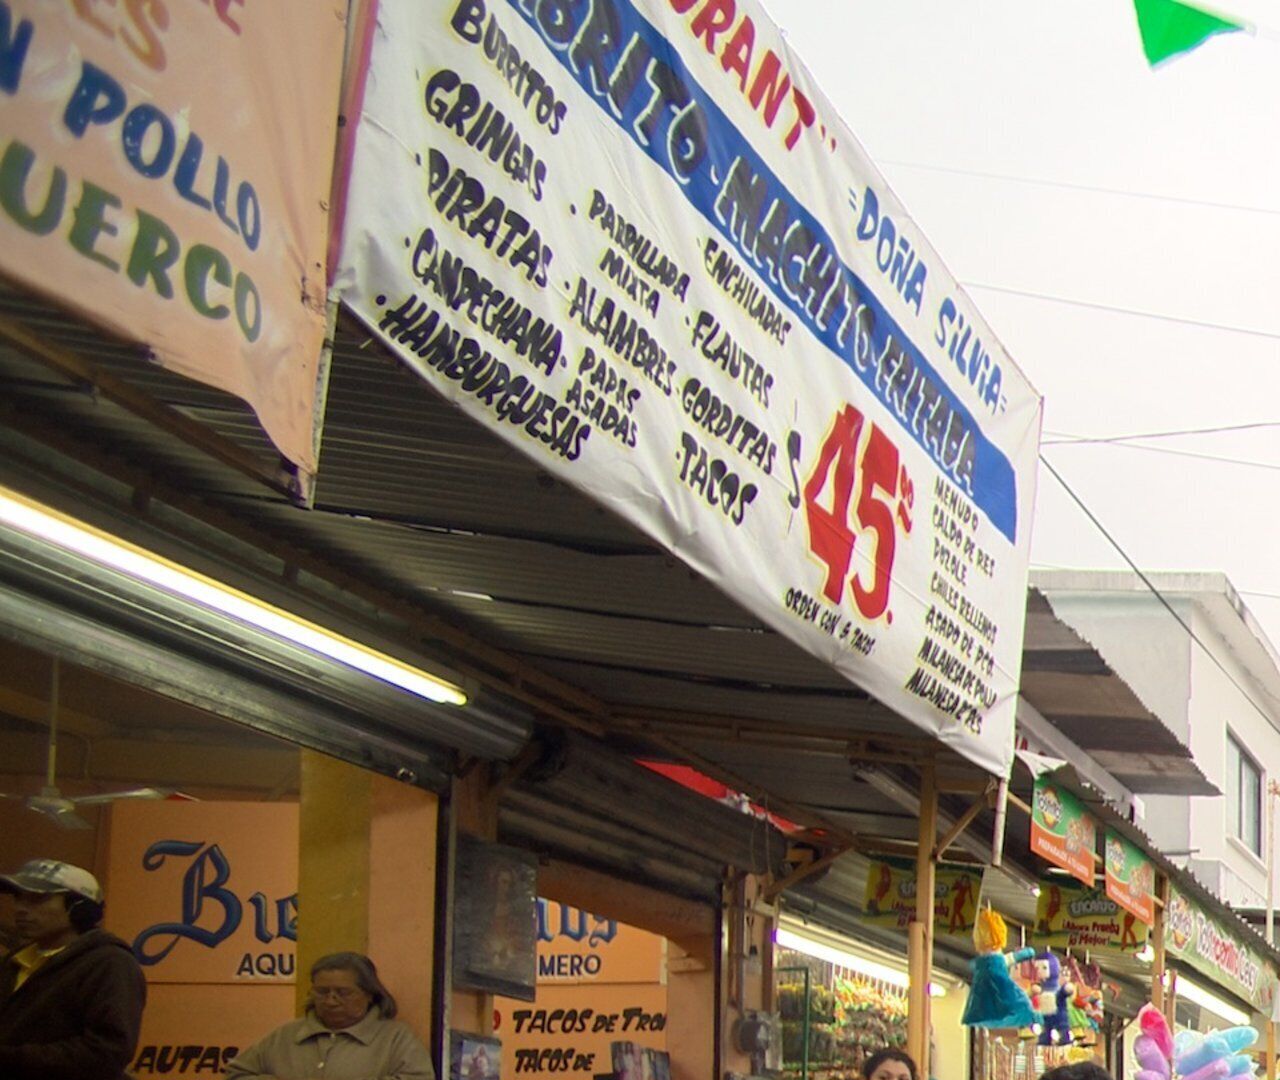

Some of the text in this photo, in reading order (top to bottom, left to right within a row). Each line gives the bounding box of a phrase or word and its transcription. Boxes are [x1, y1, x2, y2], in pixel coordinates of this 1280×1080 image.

[451, 0, 567, 135] BURRITOS
[64, 61, 261, 252] POLLO
[425, 69, 547, 202] GRINGAS
[428, 148, 554, 288] PIRATAS
[588, 189, 691, 303] PARRILLADA
[411, 228, 563, 378] CAMPECHANA
[598, 248, 661, 318] MIXTA
[703, 237, 792, 347] ENCHILADAS
[569, 278, 678, 396] ALAMBRES
[690, 310, 774, 409] FLAUTAS
[714, 156, 877, 373] MACHITO
[875, 335, 976, 496] FRITADA
[384, 295, 592, 461] HAMBURGUESAS
[566, 379, 638, 449] ASADAS
[578, 346, 641, 413] PAPAS
[681, 377, 778, 475] GORDITAS
[678, 431, 757, 525] TACOS
[934, 474, 979, 532] MENUDO
[932, 507, 996, 579] CALDO DE RES
[785, 587, 820, 622] ORDEN
[850, 628, 876, 656] TACOS
[924, 605, 961, 647] ASADO
[961, 631, 976, 656] DE
[930, 571, 997, 645] CHILES RELLENOS
[905, 667, 960, 722] MILANESA
[918, 637, 964, 690] MILANESA
[963, 667, 976, 695] DE
[236, 953, 602, 977] AQU MERO
[513, 1009, 593, 1034] TACOS
[592, 1013, 619, 1033] DE
[515, 1048, 575, 1073] TACOS
[575, 1053, 596, 1072] DE
